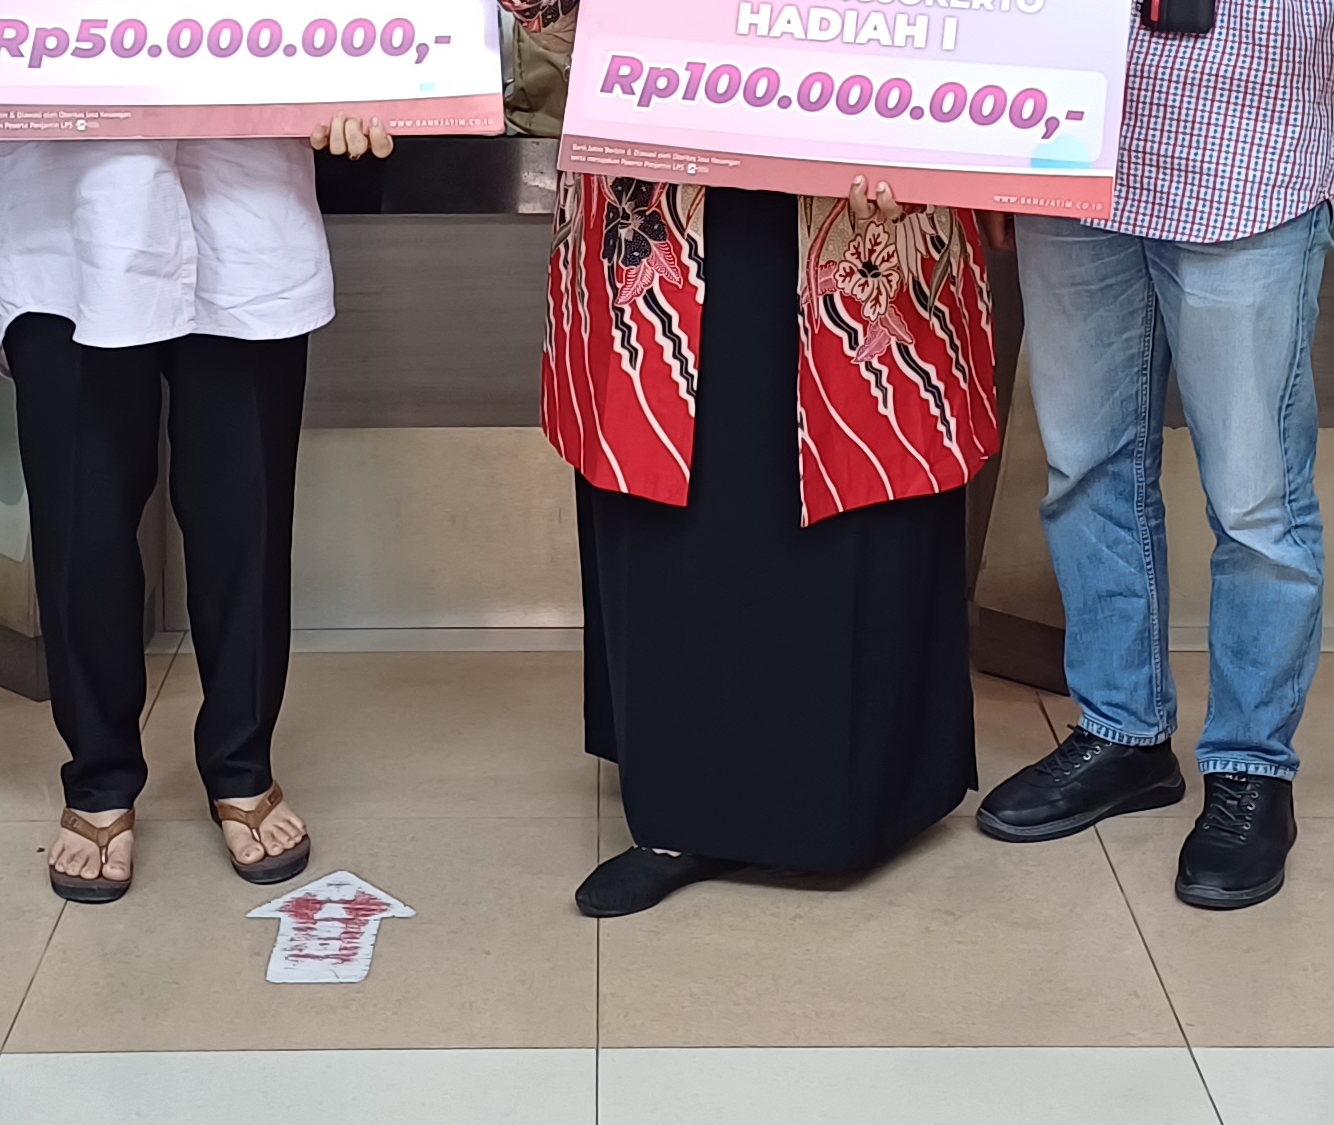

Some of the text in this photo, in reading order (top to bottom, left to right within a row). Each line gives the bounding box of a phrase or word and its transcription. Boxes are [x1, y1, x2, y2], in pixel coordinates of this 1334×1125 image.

[735, 1, 959, 51] HADIAH I
[600, 54, 1085, 139] Rp100.000.000,-
